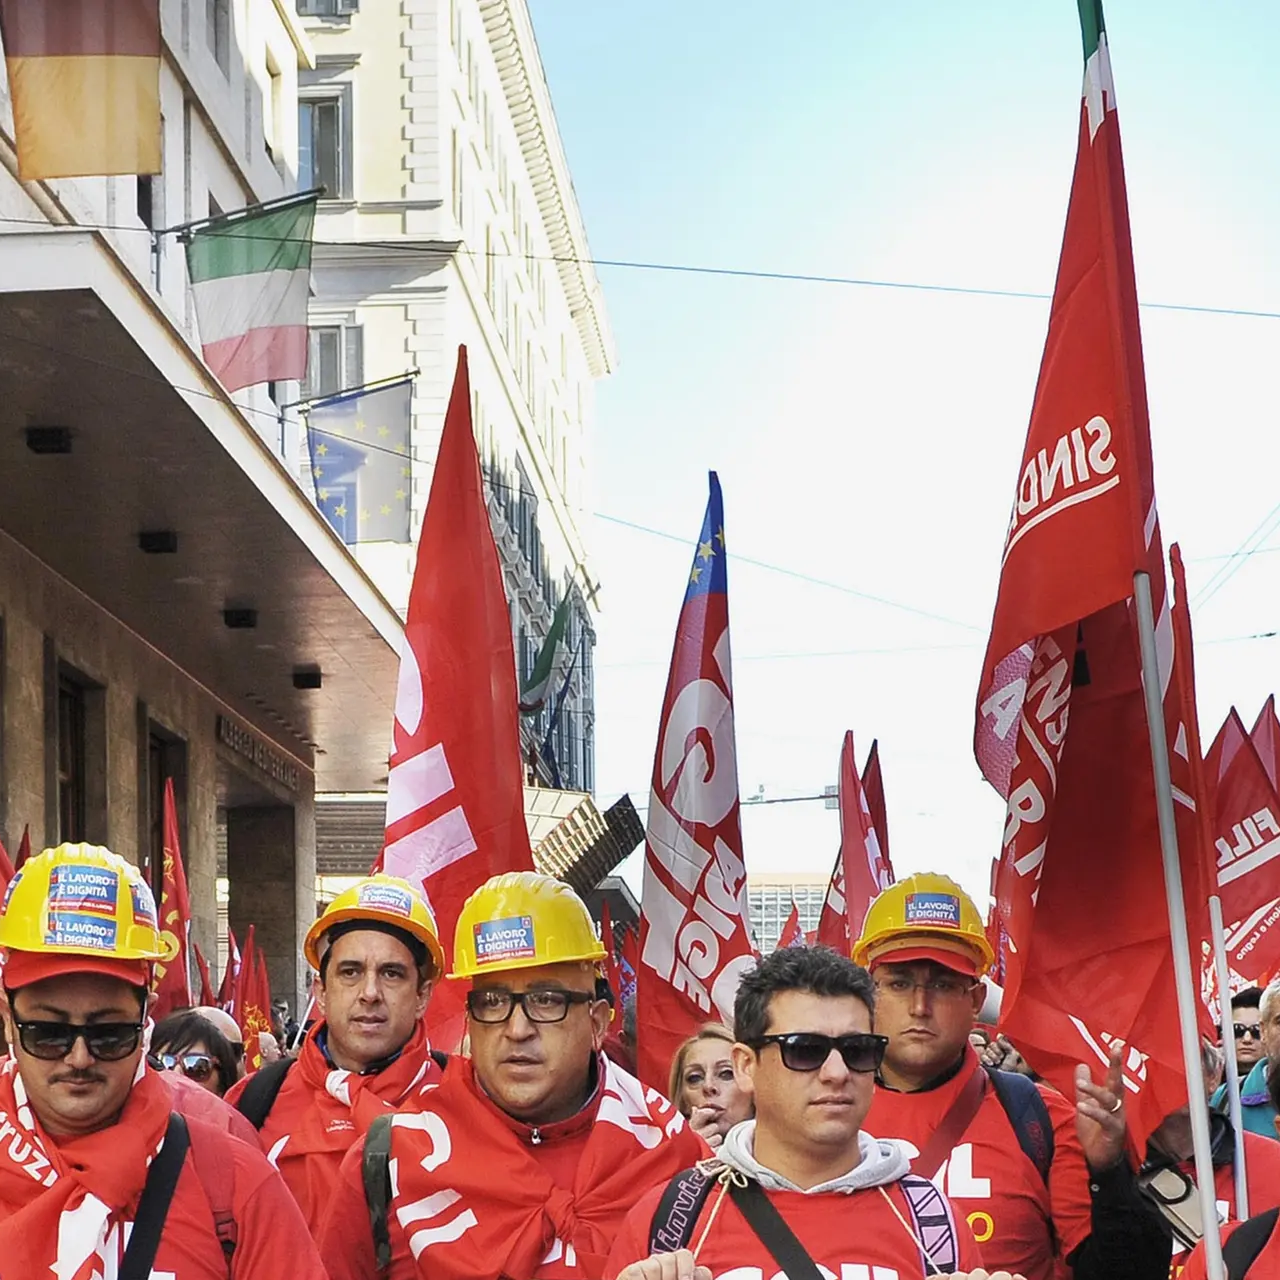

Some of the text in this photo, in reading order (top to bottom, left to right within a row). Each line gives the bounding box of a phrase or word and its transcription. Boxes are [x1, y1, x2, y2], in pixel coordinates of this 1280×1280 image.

[69, 872, 110, 885] LAVORO
[67, 884, 108, 898] DIGNITÀ
[918, 902, 956, 912] LAVORO
[65, 922, 107, 936] LAVORO
[485, 928, 527, 943] LAVORO
[485, 938, 529, 953] DIGNITÀ
